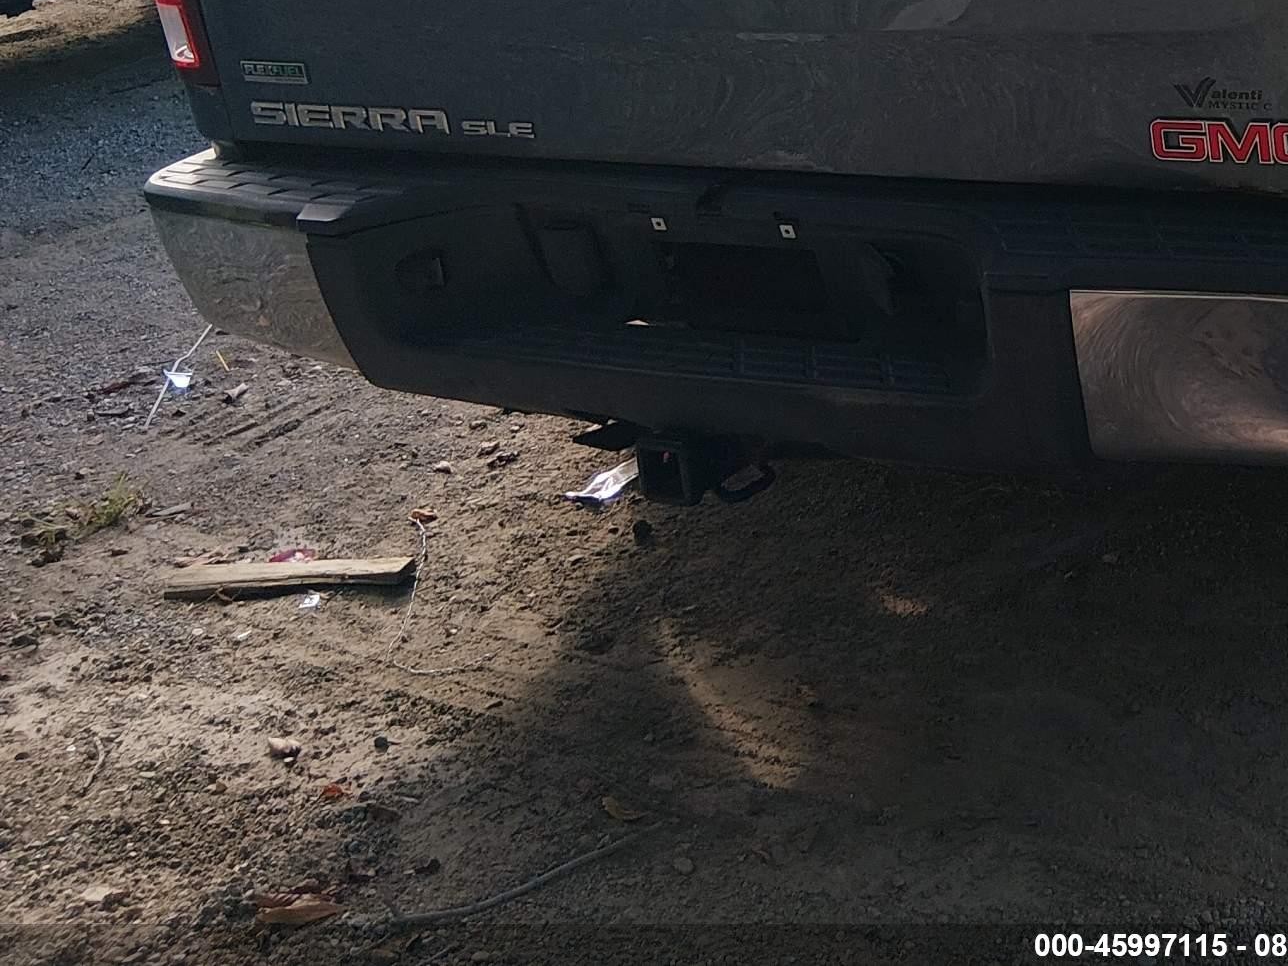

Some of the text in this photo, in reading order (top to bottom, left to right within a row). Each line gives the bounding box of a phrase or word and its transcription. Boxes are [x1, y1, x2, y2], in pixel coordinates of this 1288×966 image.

[1172, 76, 1263, 109] Valenti
[250, 101, 536, 139] SIERRA SLE
